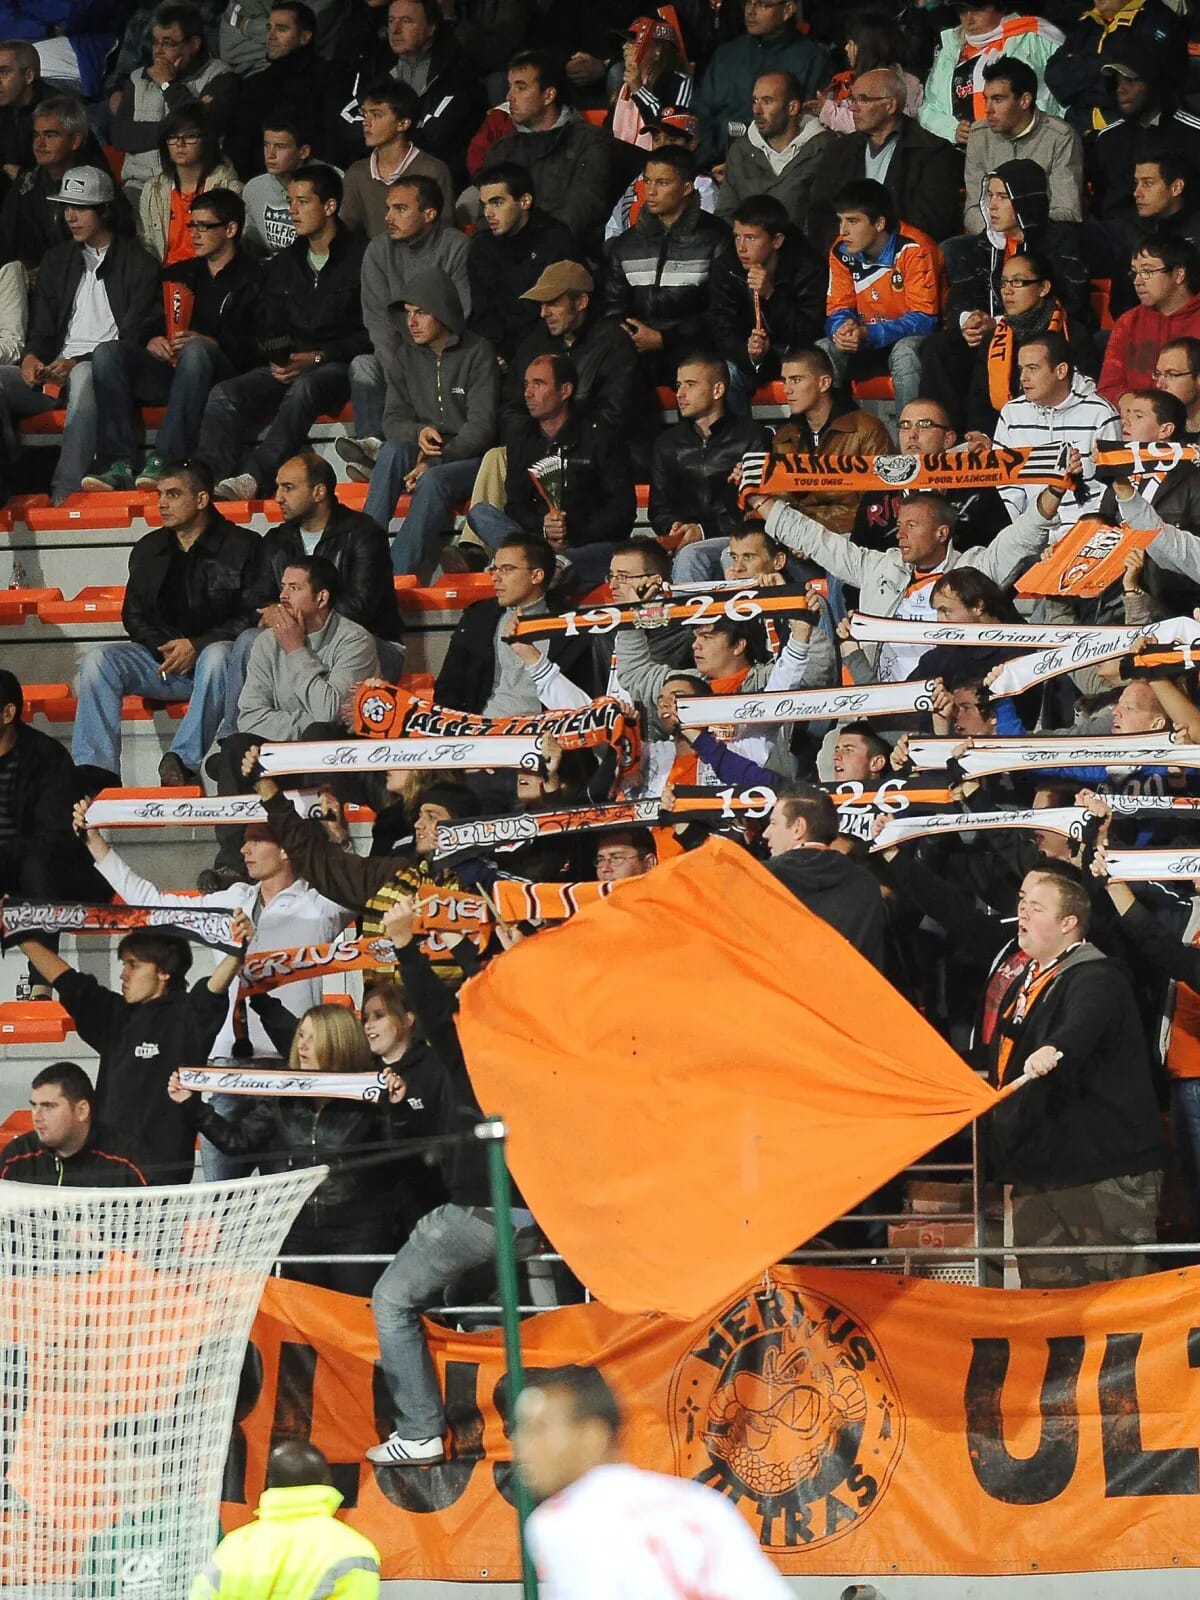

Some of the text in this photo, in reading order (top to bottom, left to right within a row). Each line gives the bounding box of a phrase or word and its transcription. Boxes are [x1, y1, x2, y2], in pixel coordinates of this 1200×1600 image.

[265, 221, 297, 238] HILFIG
[1071, 636, 1123, 660] Oriant
[775, 698, 829, 716] Oriant
[832, 694, 870, 712] FC
[371, 745, 428, 765] Oriant
[429, 744, 475, 762] FC
